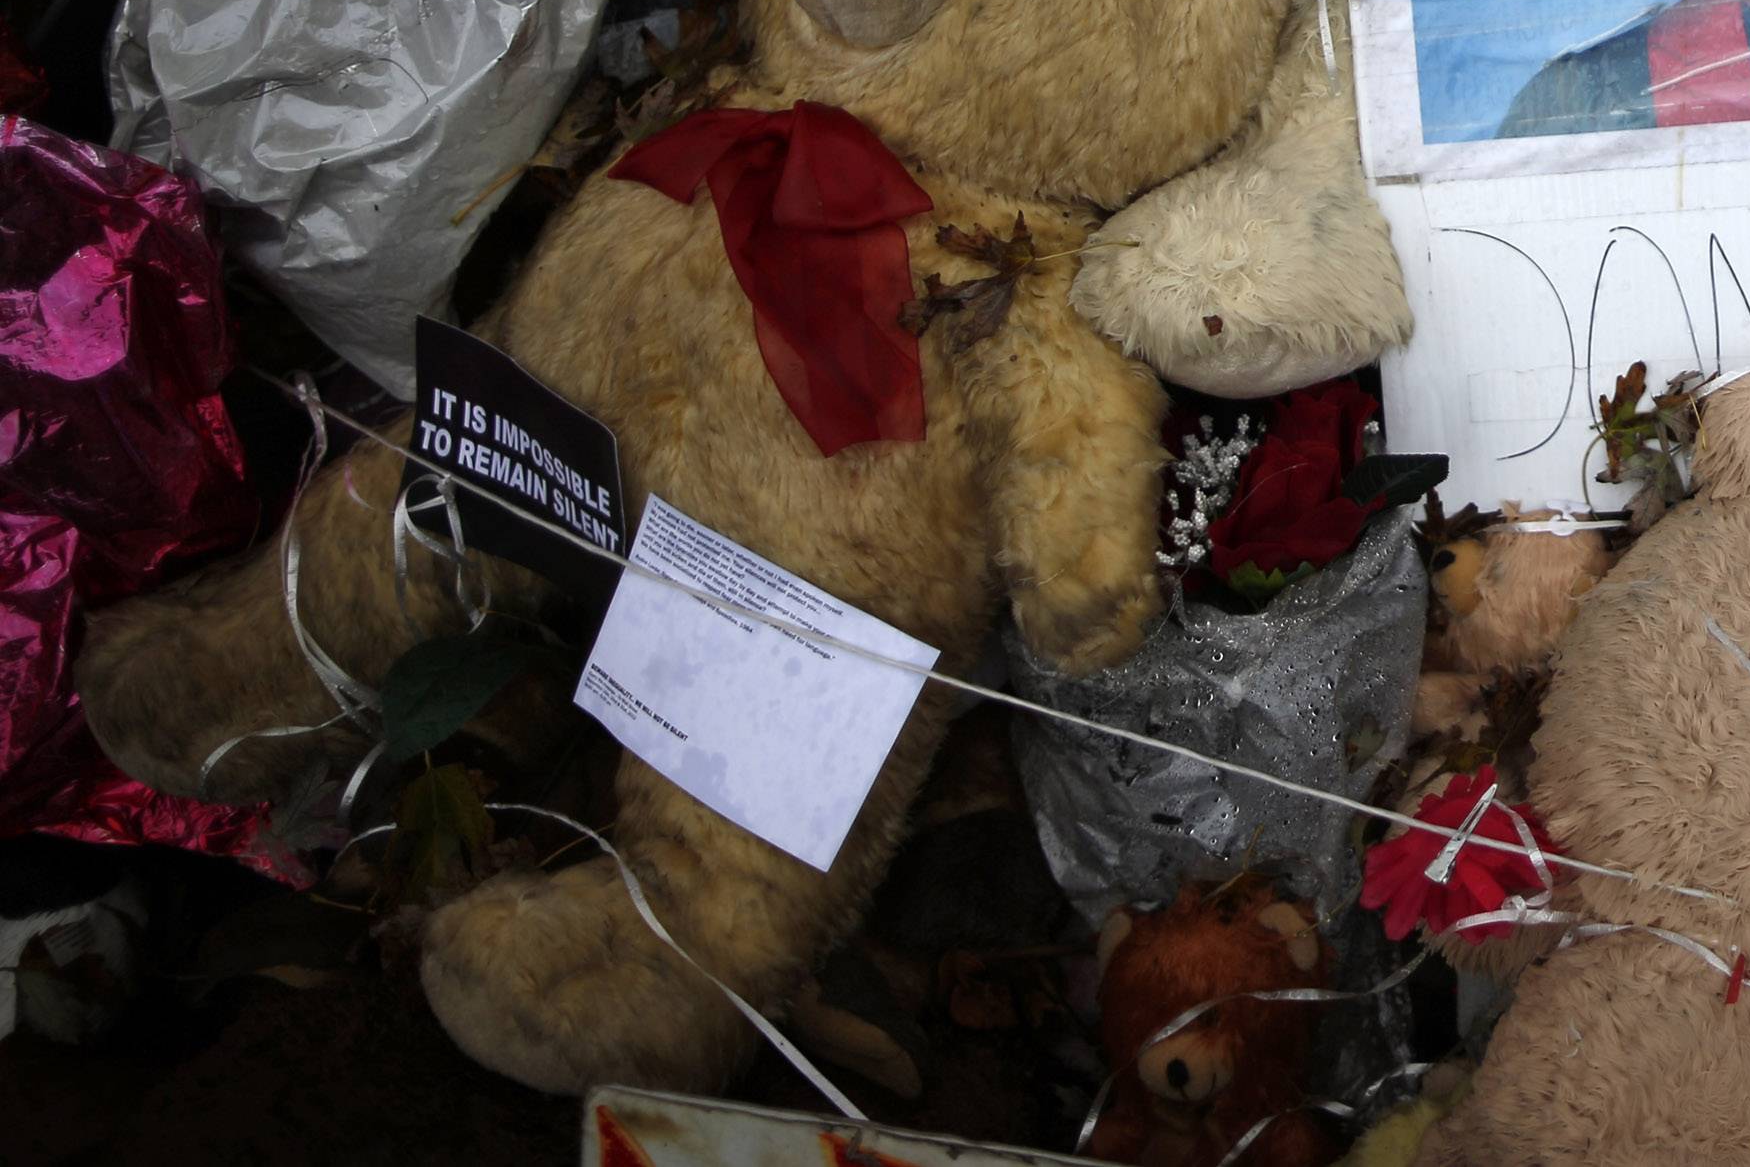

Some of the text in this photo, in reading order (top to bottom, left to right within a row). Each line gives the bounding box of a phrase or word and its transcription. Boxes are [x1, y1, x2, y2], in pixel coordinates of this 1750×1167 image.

[420, 420, 619, 553] TO REMAIN SILENT
[433, 387, 612, 517] IT IS IMPOSSIBLE
